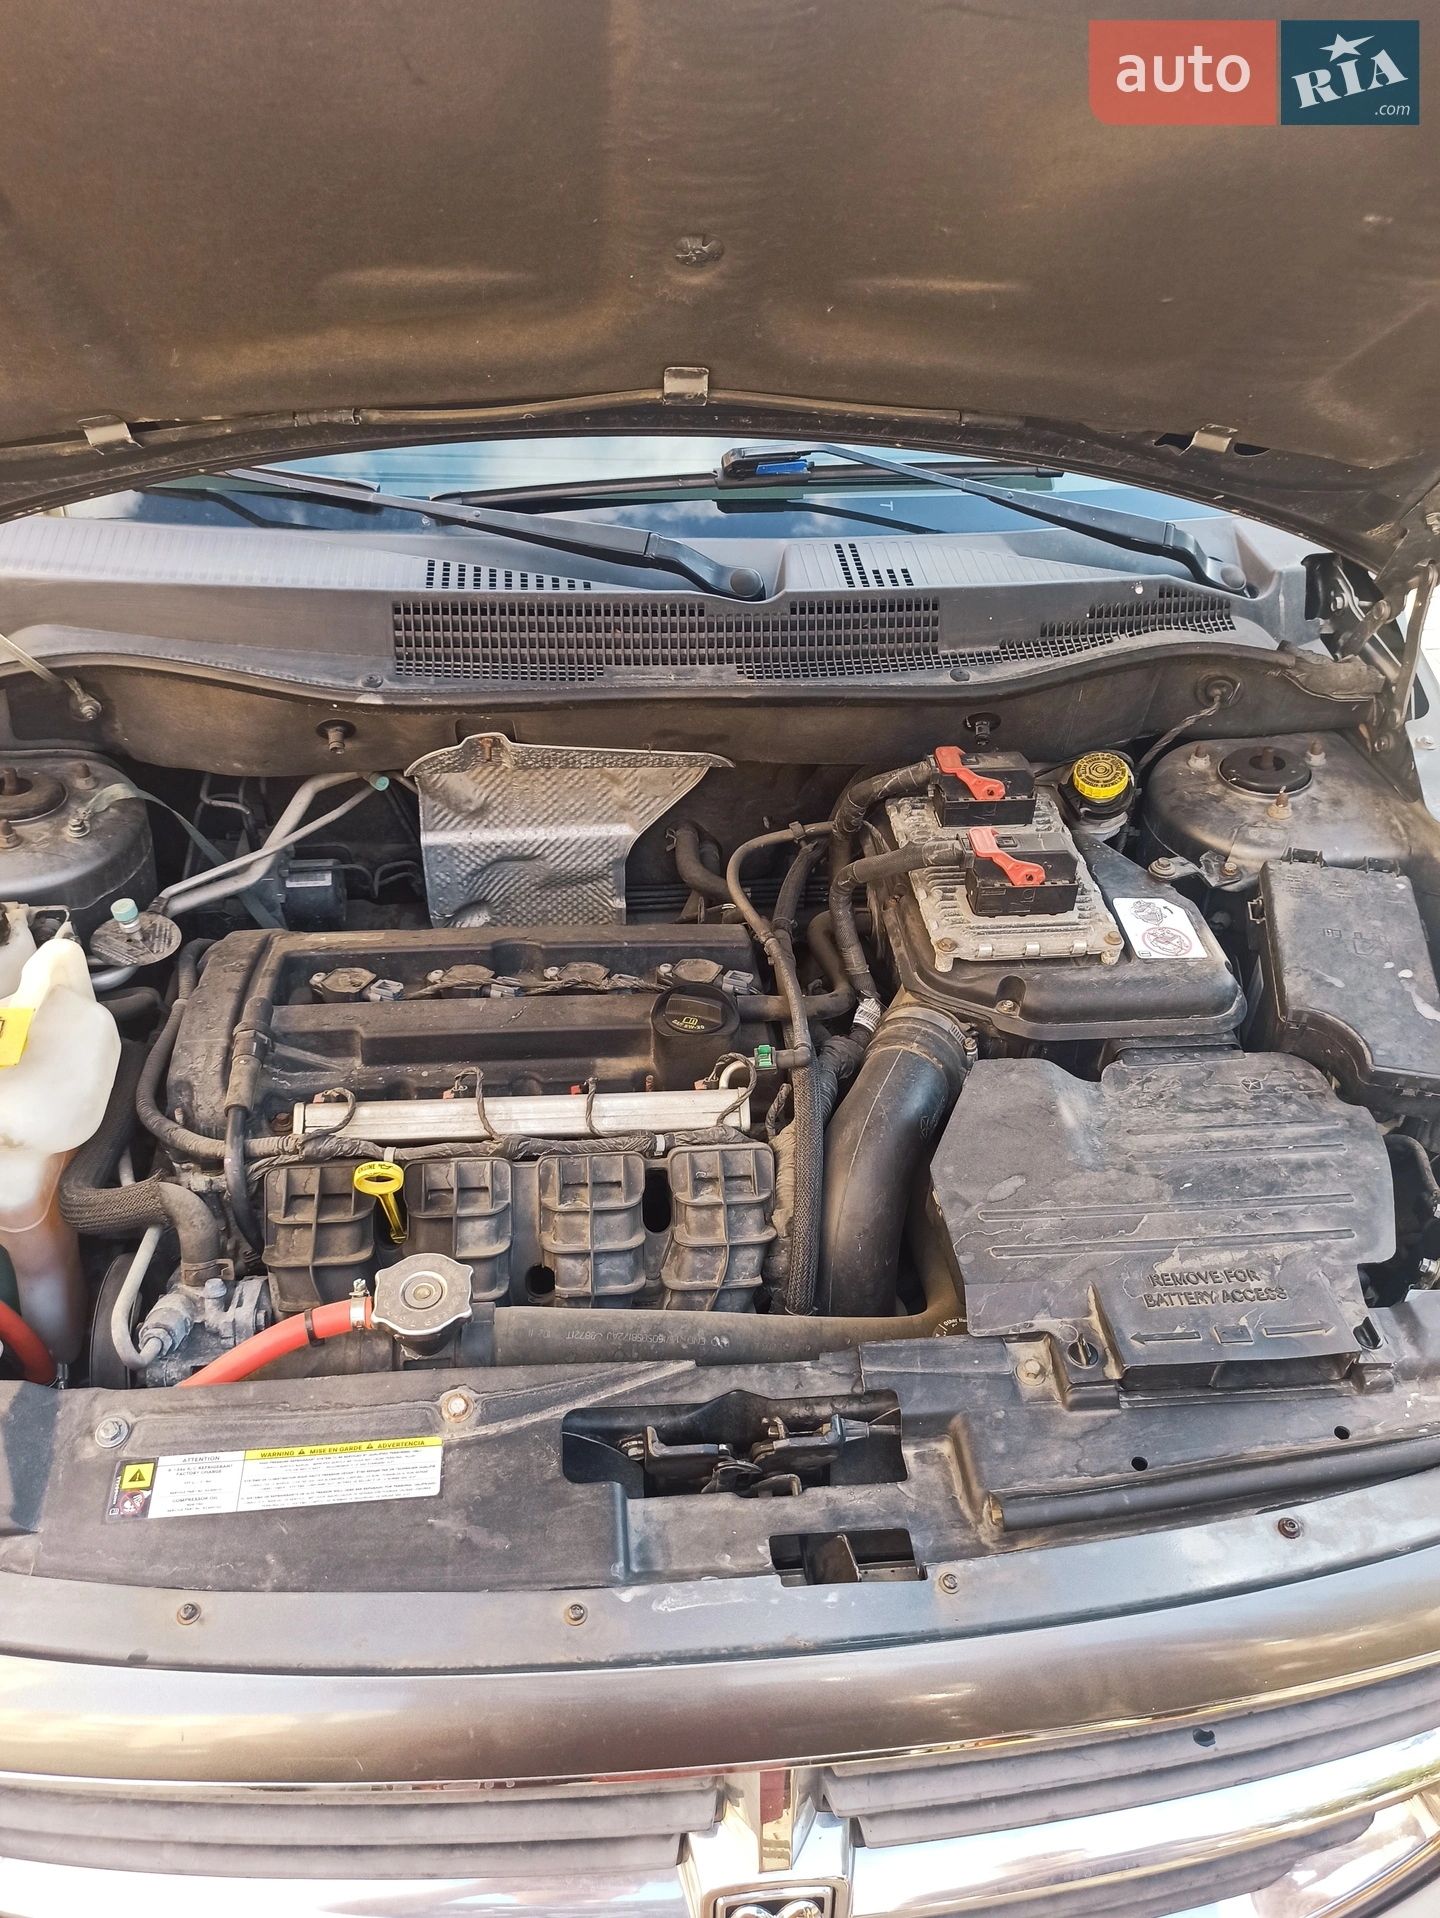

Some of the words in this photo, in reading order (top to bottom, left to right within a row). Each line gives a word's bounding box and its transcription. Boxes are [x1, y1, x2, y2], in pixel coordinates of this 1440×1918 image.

[1147, 1270, 1222, 1288] REMOVE
[1224, 1268, 1261, 1284] FOR
[1143, 1291, 1219, 1308] BATTERY
[1222, 1287, 1288, 1303] ACCESS
[260, 1449, 295, 1458] WARNING
[377, 1440, 425, 1449] ADVERTENCIA
[182, 1455, 220, 1463] ATTENTION
